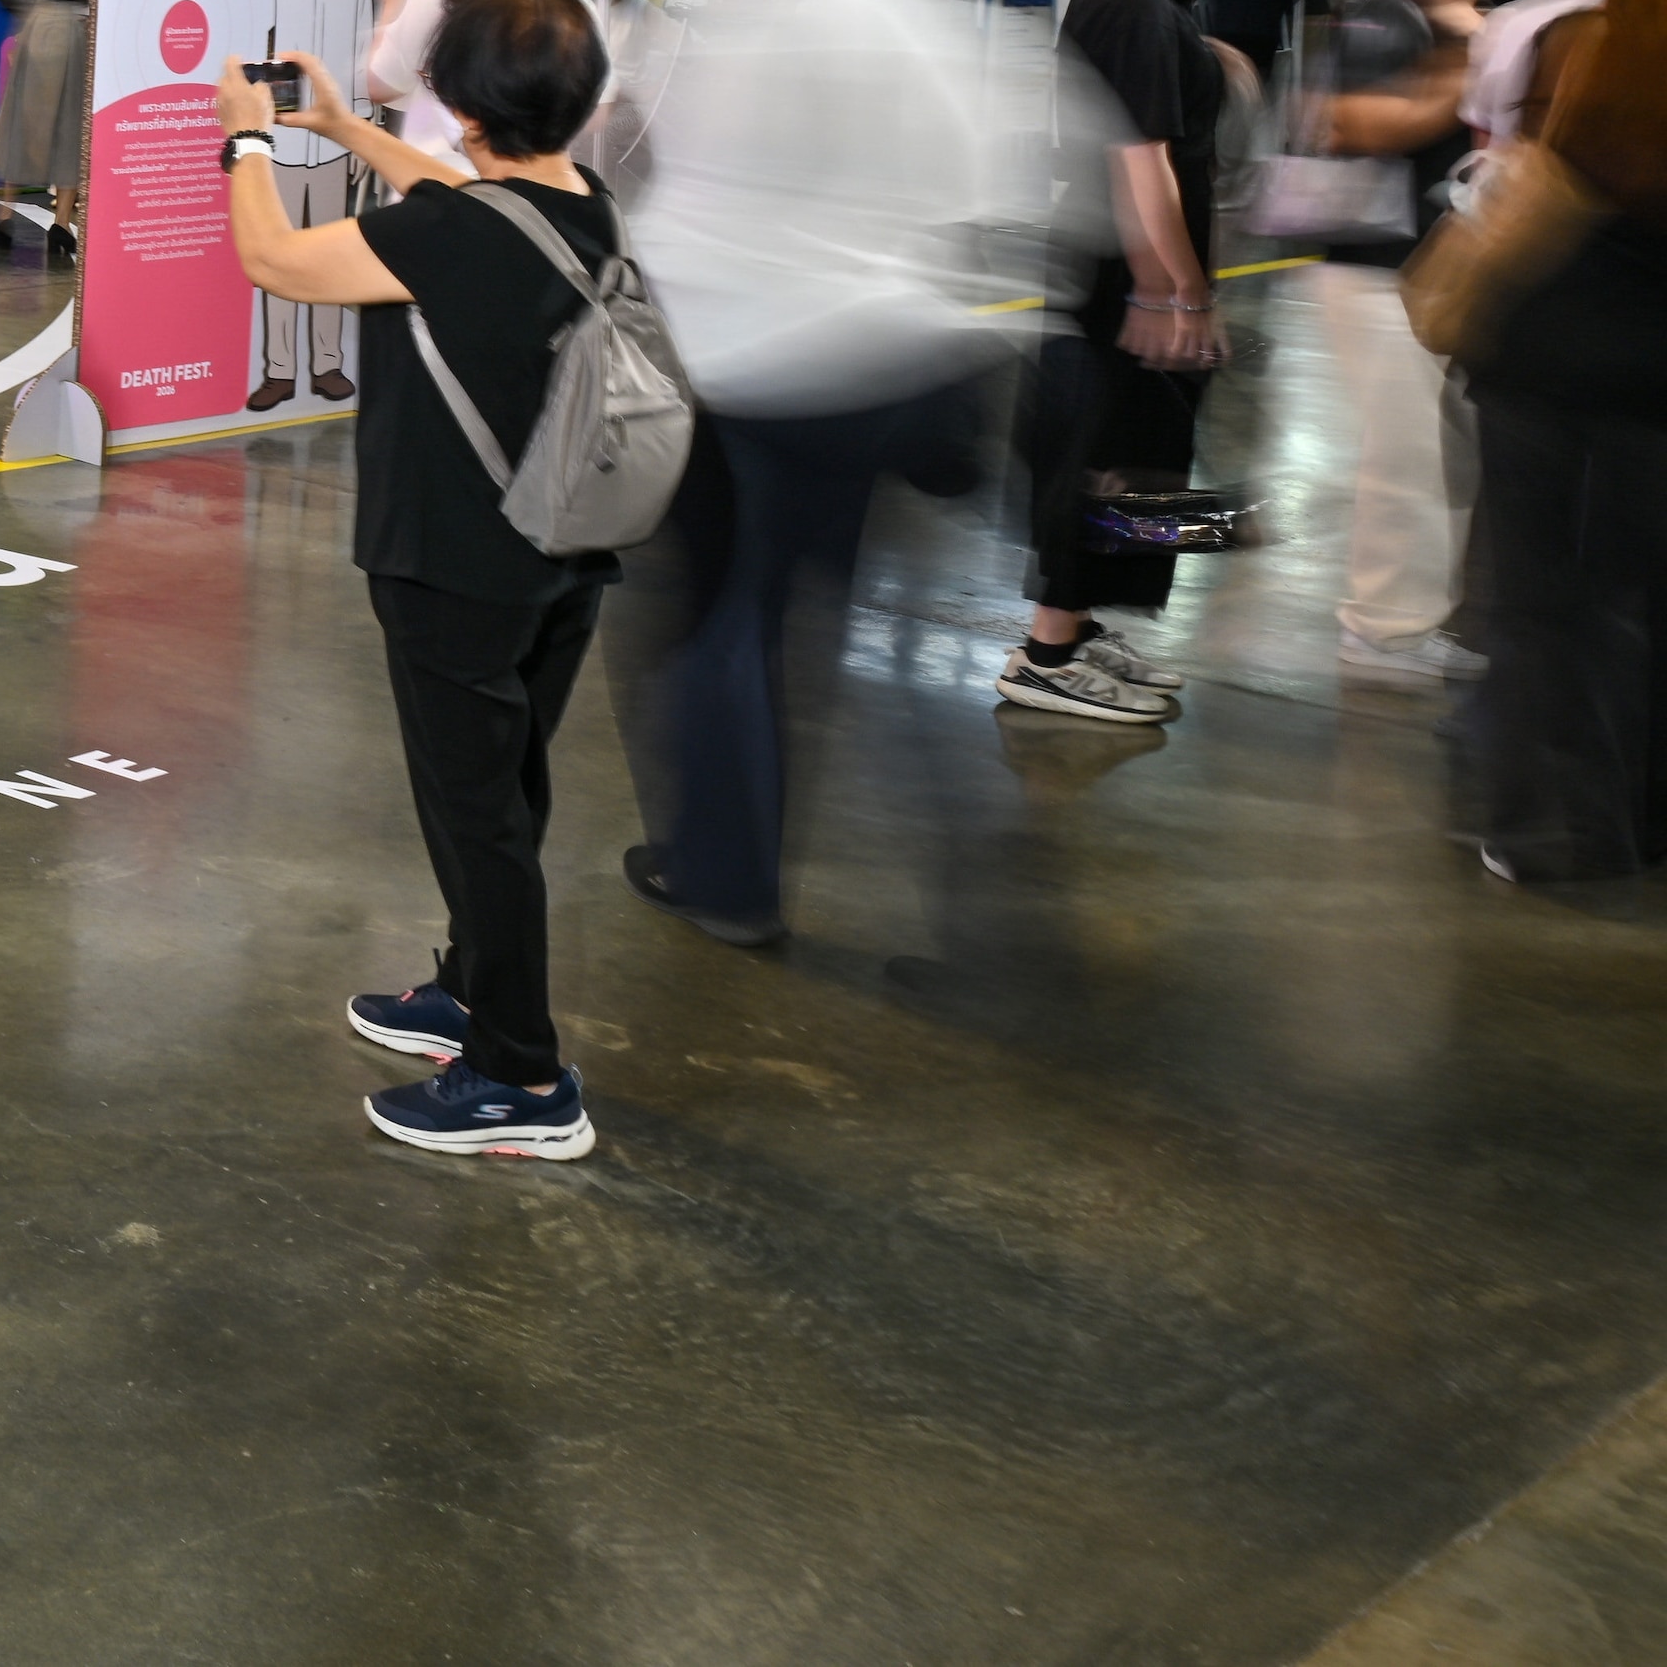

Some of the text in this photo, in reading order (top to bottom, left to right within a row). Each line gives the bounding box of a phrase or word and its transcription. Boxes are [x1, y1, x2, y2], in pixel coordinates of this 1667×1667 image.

[139, 97, 210, 114] เพราะความสัมพันธ์
[120, 360, 213, 389] DEATH FEST.
[155, 385, 176, 397] 2026
